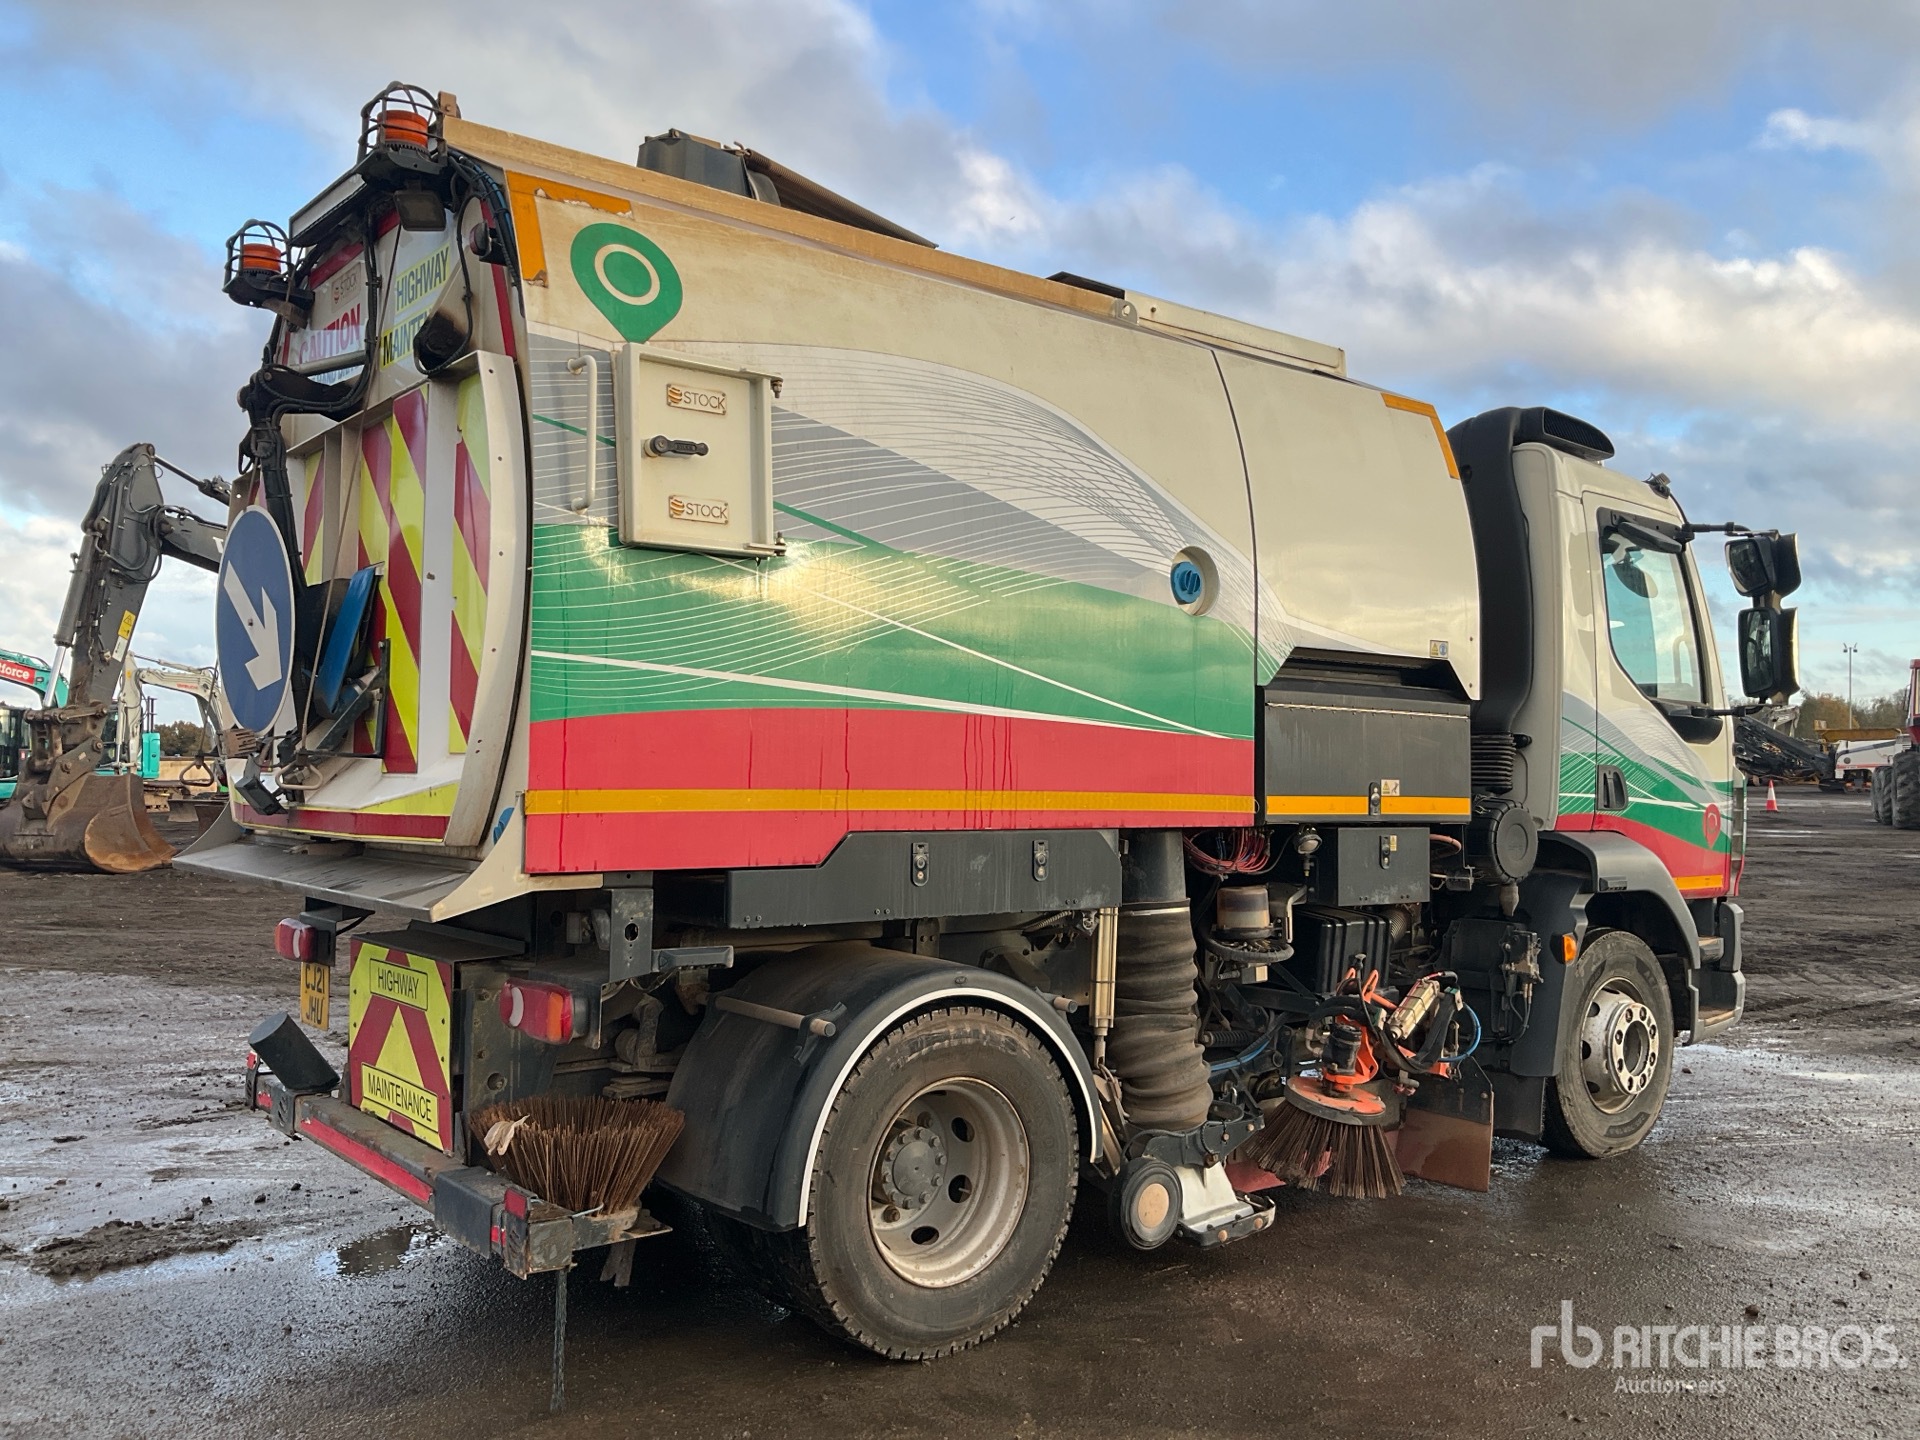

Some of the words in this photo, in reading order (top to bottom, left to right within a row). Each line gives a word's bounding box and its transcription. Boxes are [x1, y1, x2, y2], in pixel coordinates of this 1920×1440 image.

[396, 246, 449, 311] HIGHWAY
[683, 391, 726, 409] STOCK
[686, 503, 728, 519] STOCK
[0, 662, 30, 680] force
[377, 967, 420, 999] HIGHWAY
[367, 1072, 433, 1122] MAINTENANCE
